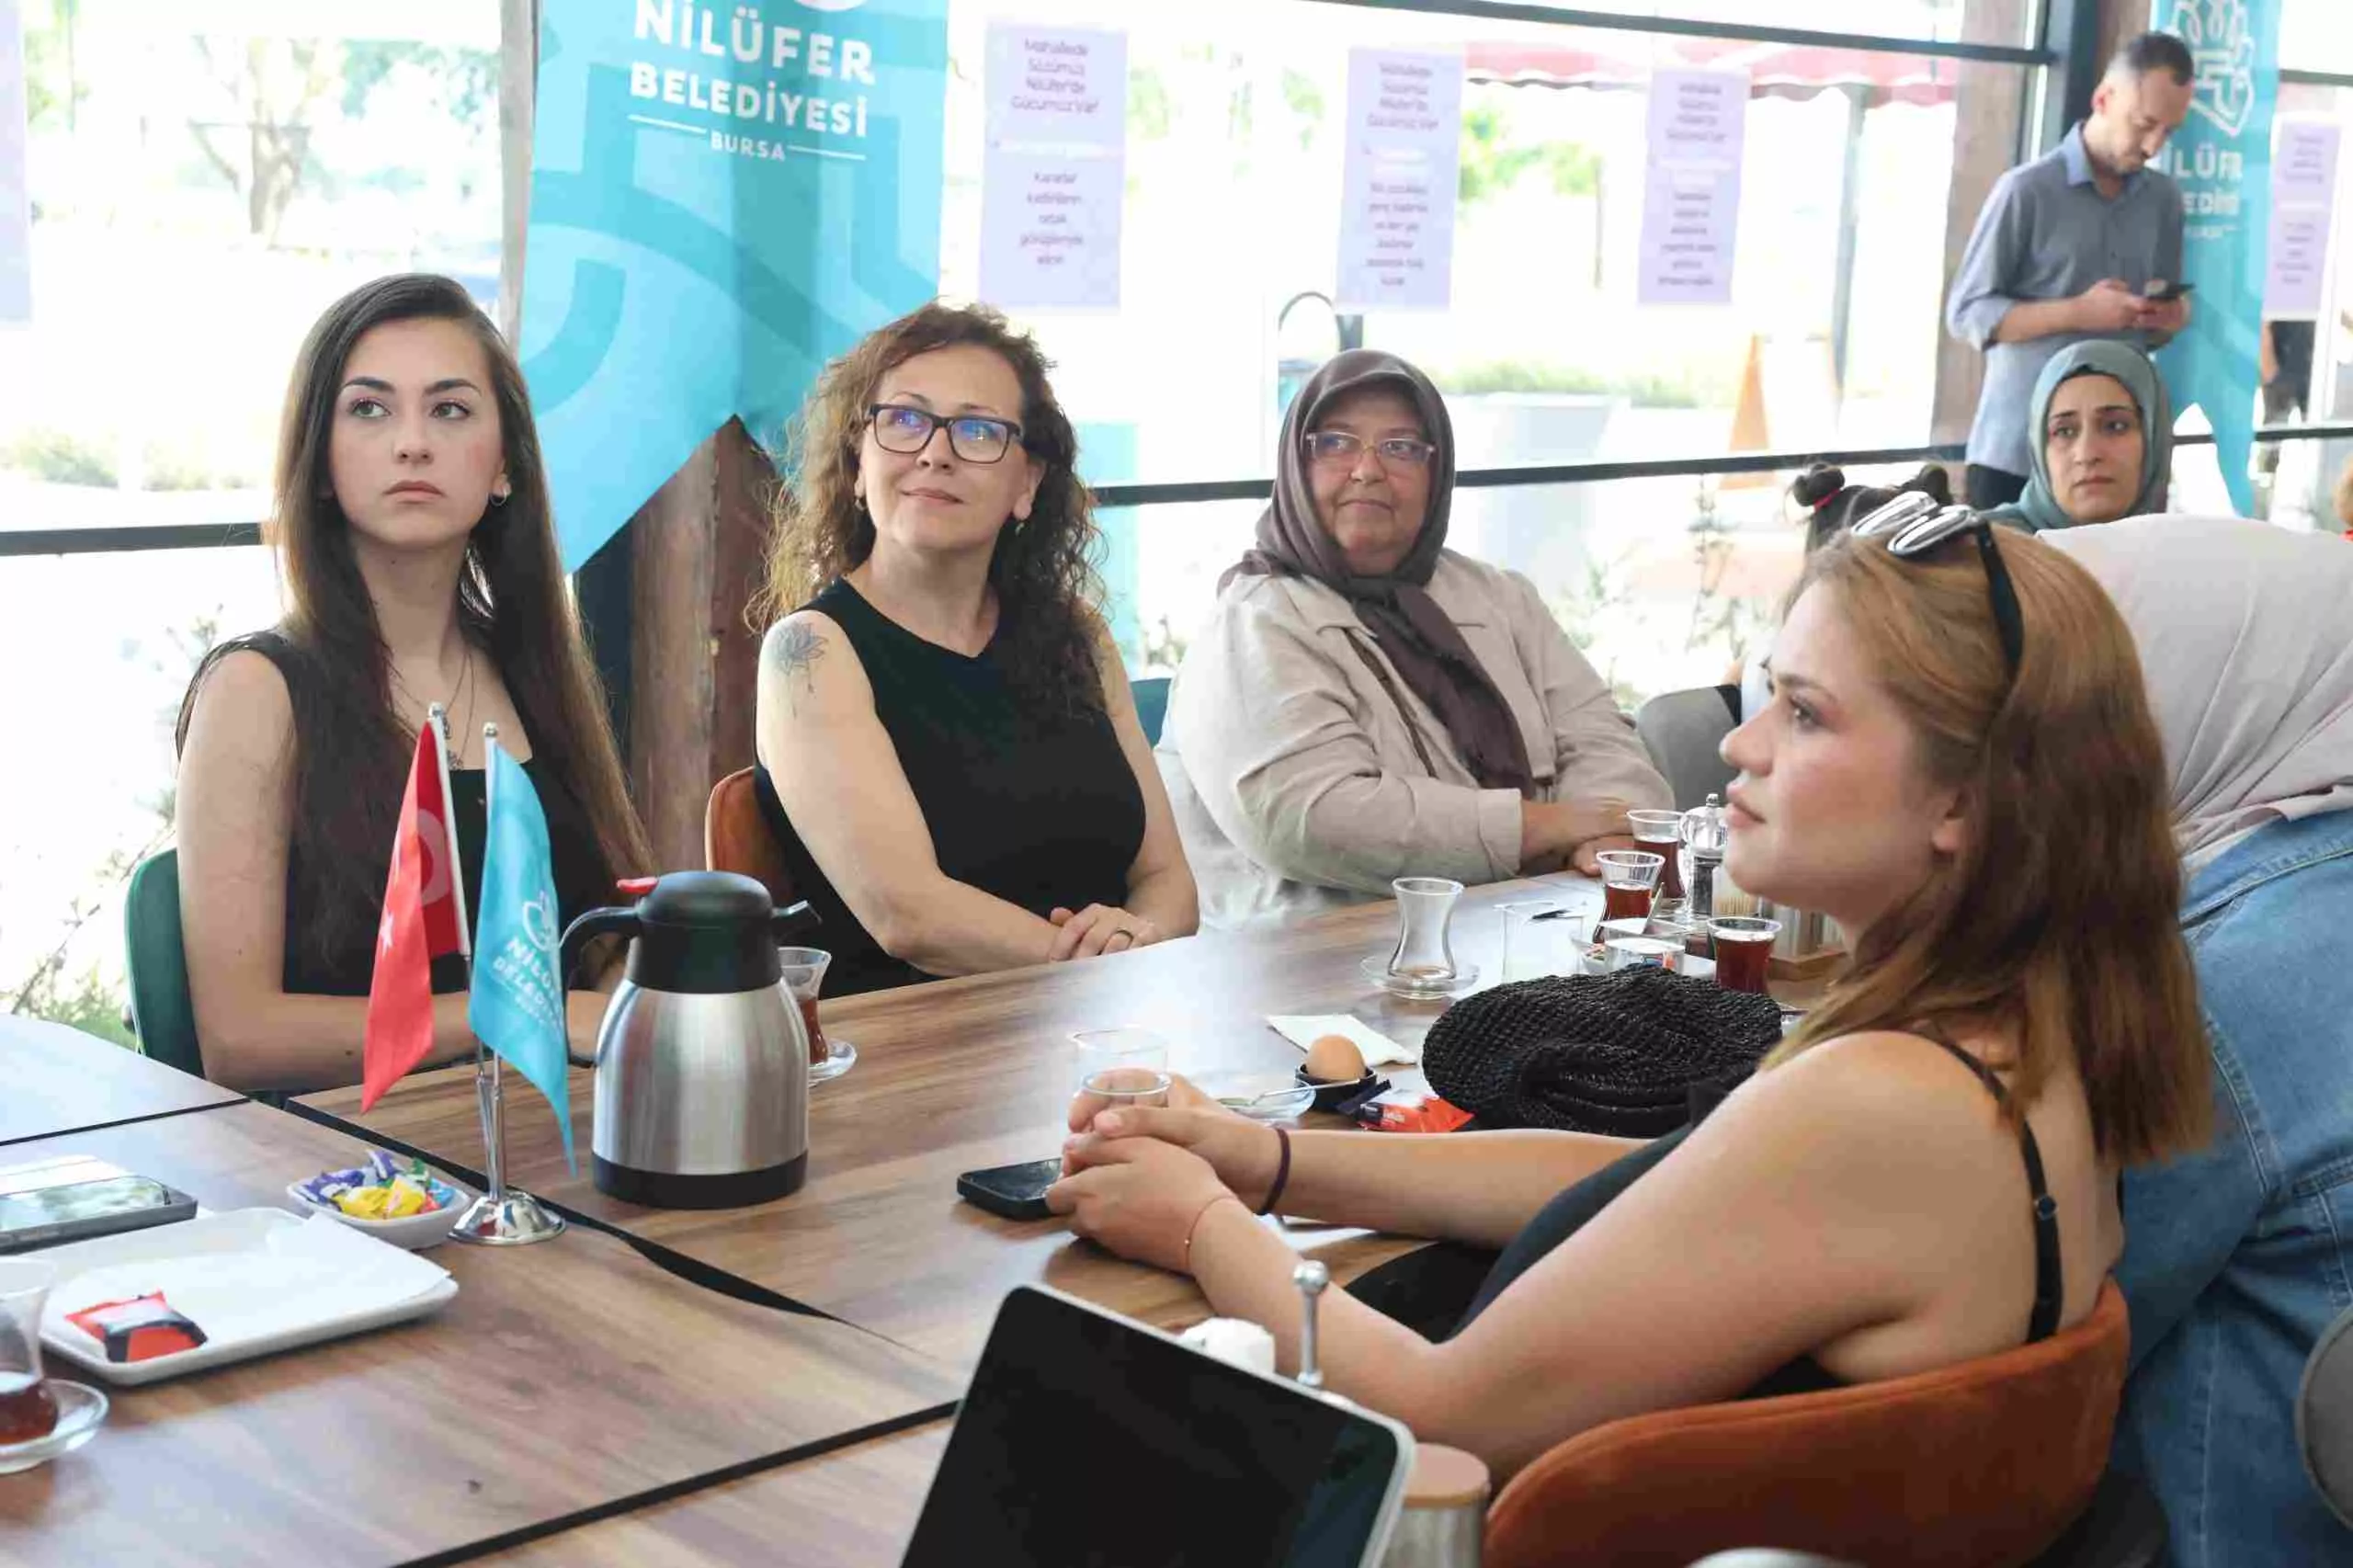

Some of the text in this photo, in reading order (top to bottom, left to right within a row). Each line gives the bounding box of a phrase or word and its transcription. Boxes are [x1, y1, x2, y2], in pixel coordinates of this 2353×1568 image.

[634, 0, 875, 85] NİLÜFER
[631, 61, 868, 138] BELEDİYESİ
[710, 131, 785, 162] BURSA
